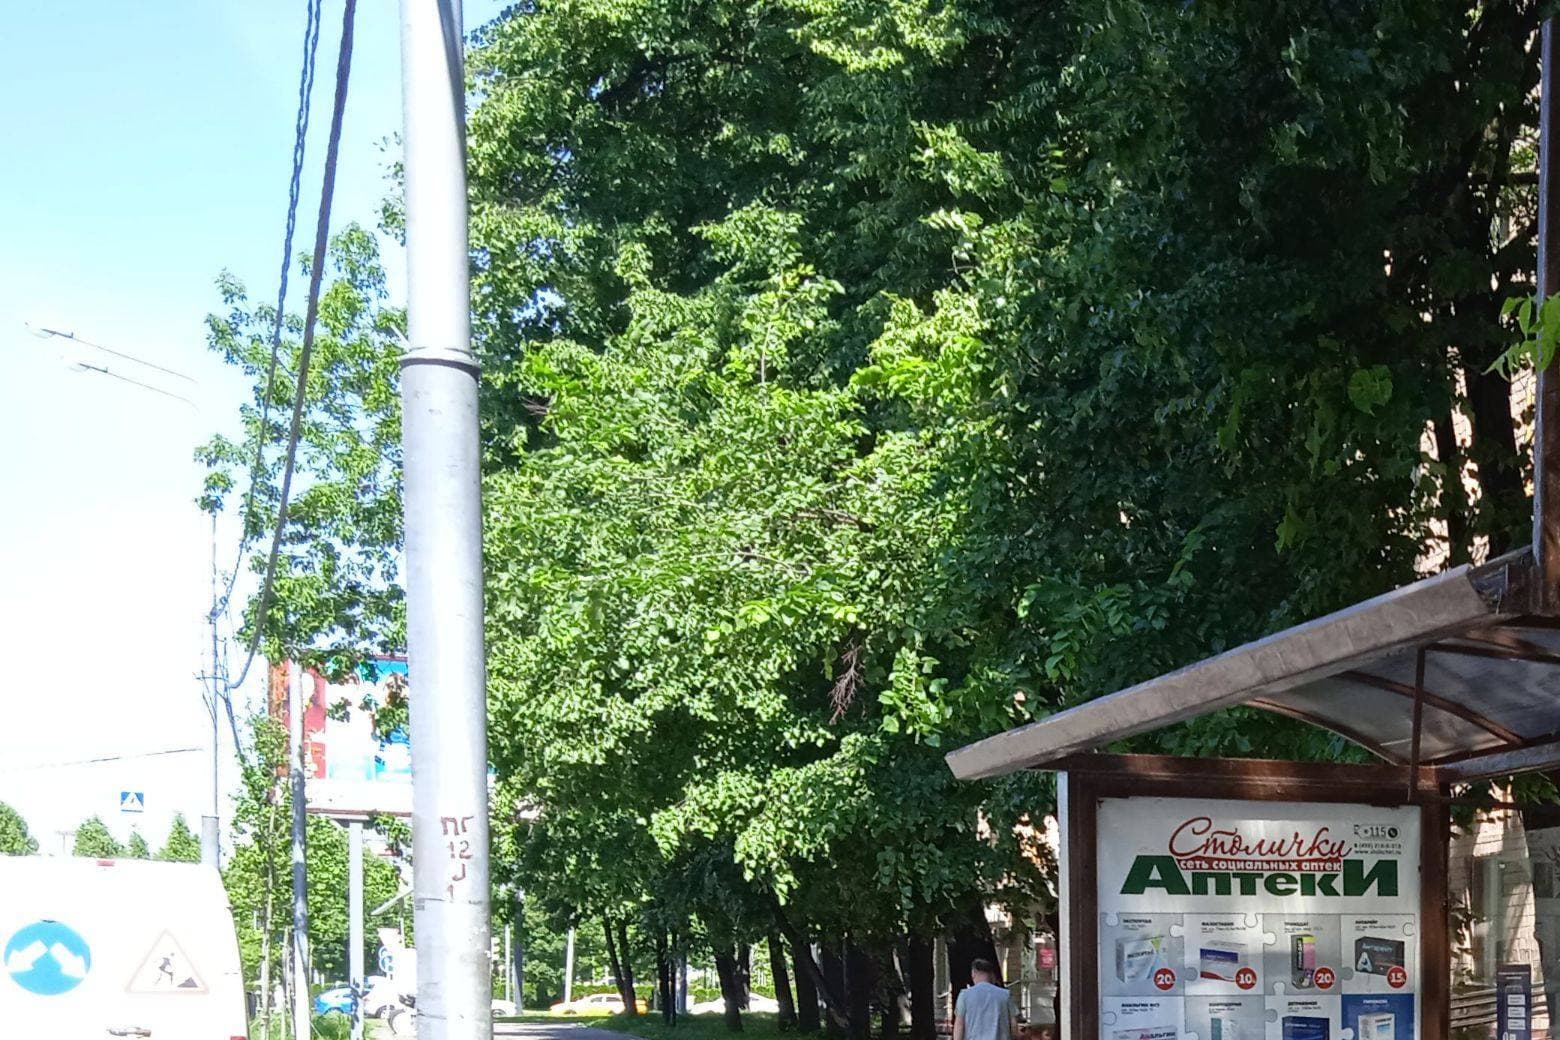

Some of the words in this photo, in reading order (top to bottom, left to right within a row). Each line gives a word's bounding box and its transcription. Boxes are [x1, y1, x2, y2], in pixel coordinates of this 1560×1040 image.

[1168, 816, 1353, 857] Столички
[1180, 859, 1209, 869] сеть
[1212, 859, 1299, 871] социальных
[1301, 860, 1342, 872] аптек
